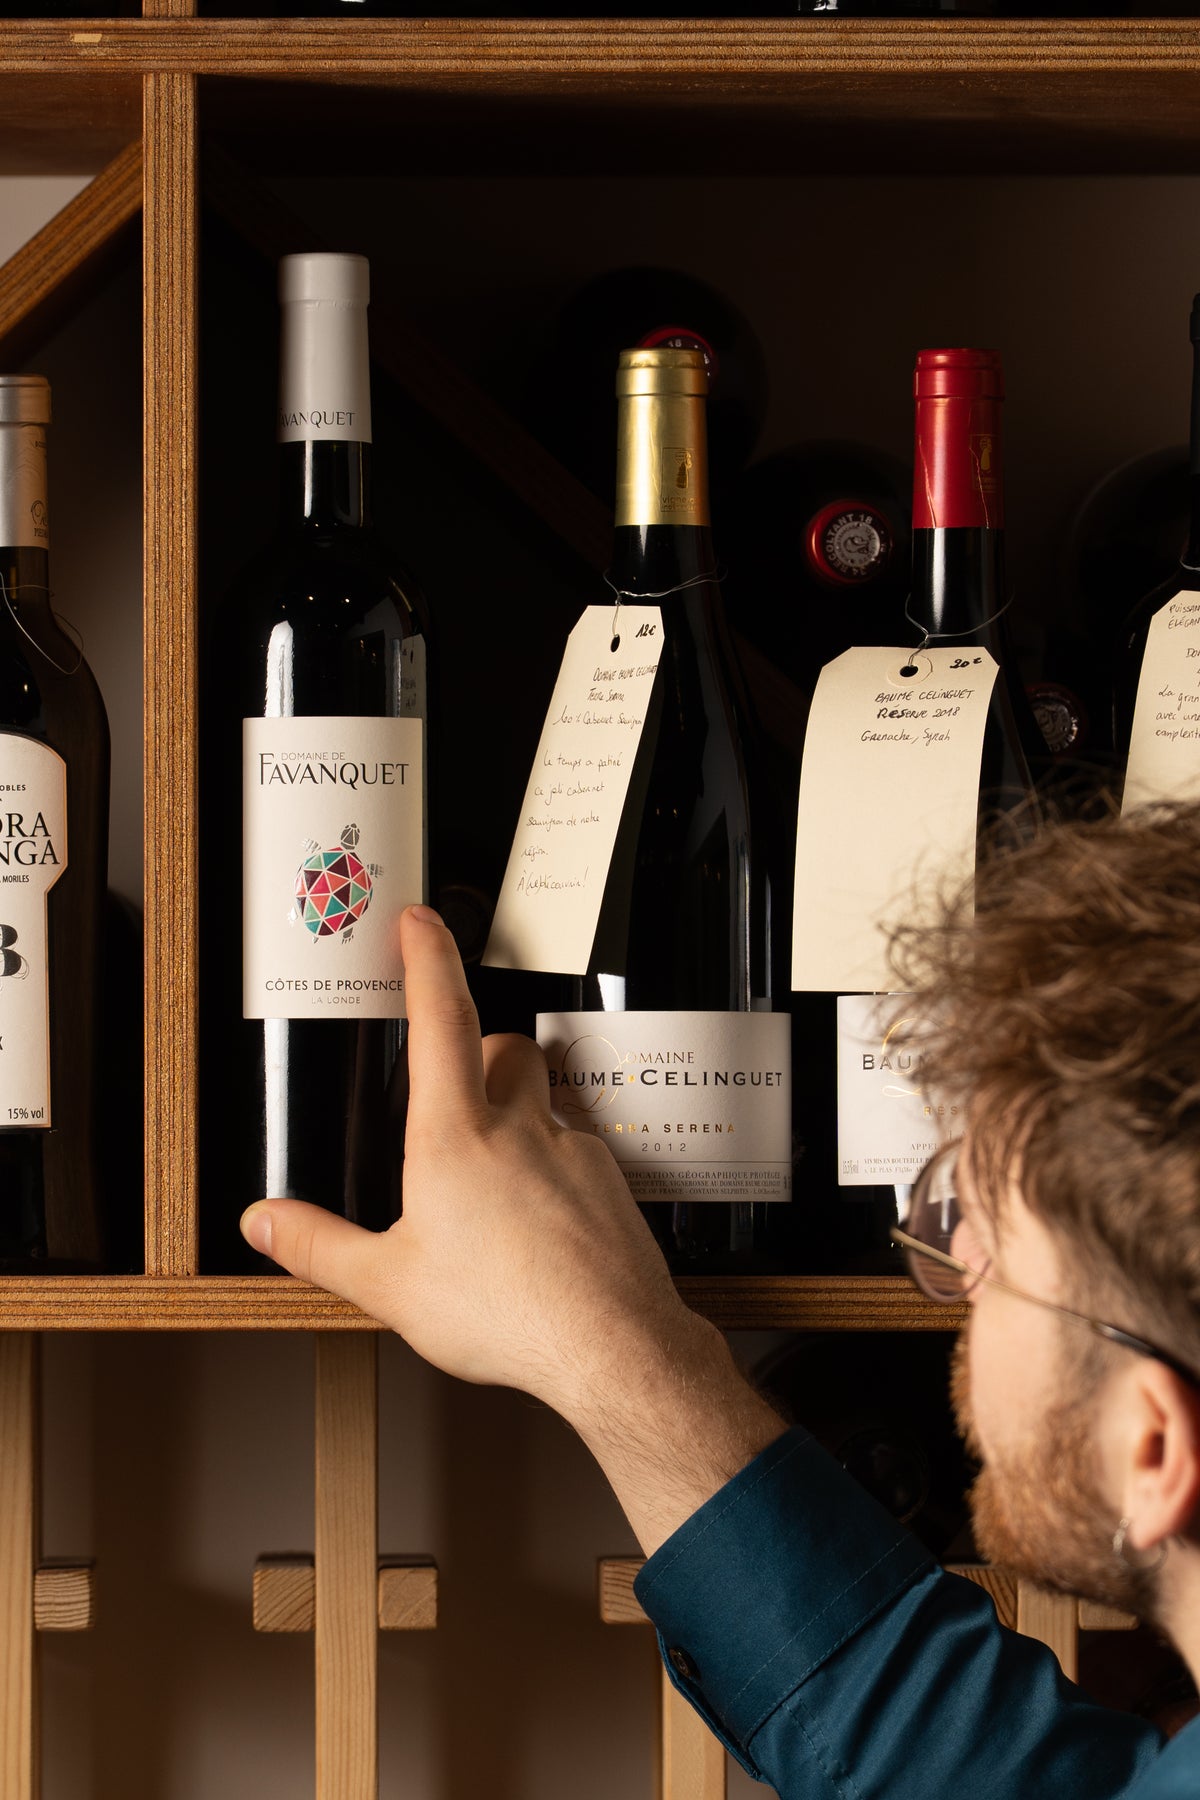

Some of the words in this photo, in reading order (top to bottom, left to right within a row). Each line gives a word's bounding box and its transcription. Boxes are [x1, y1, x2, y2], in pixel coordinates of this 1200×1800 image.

[874, 690, 914, 703] BAUME
[932, 707, 961, 718] 2018
[1155, 711, 1176, 721] avec
[922, 727, 951, 747] Syrah
[281, 752, 328, 761] DOMAINE
[331, 752, 346, 760] DE
[585, 759, 593, 767] a
[258, 752, 410, 791] FAVANQUET
[2, 875, 30, 883] MORILES
[265, 977, 308, 991] CÔTES
[313, 980, 332, 991] DE
[337, 980, 403, 991] PROVENCE
[311, 996, 323, 1004] LA
[327, 996, 361, 1005] LONDE
[549, 1071, 624, 1087] BAUME
[640, 1069, 783, 1087] CELINGUET
[8, 1107, 29, 1120] 15%
[31, 1107, 44, 1119] vol
[664, 1123, 735, 1133] SERENA
[641, 1143, 687, 1152] 2012
